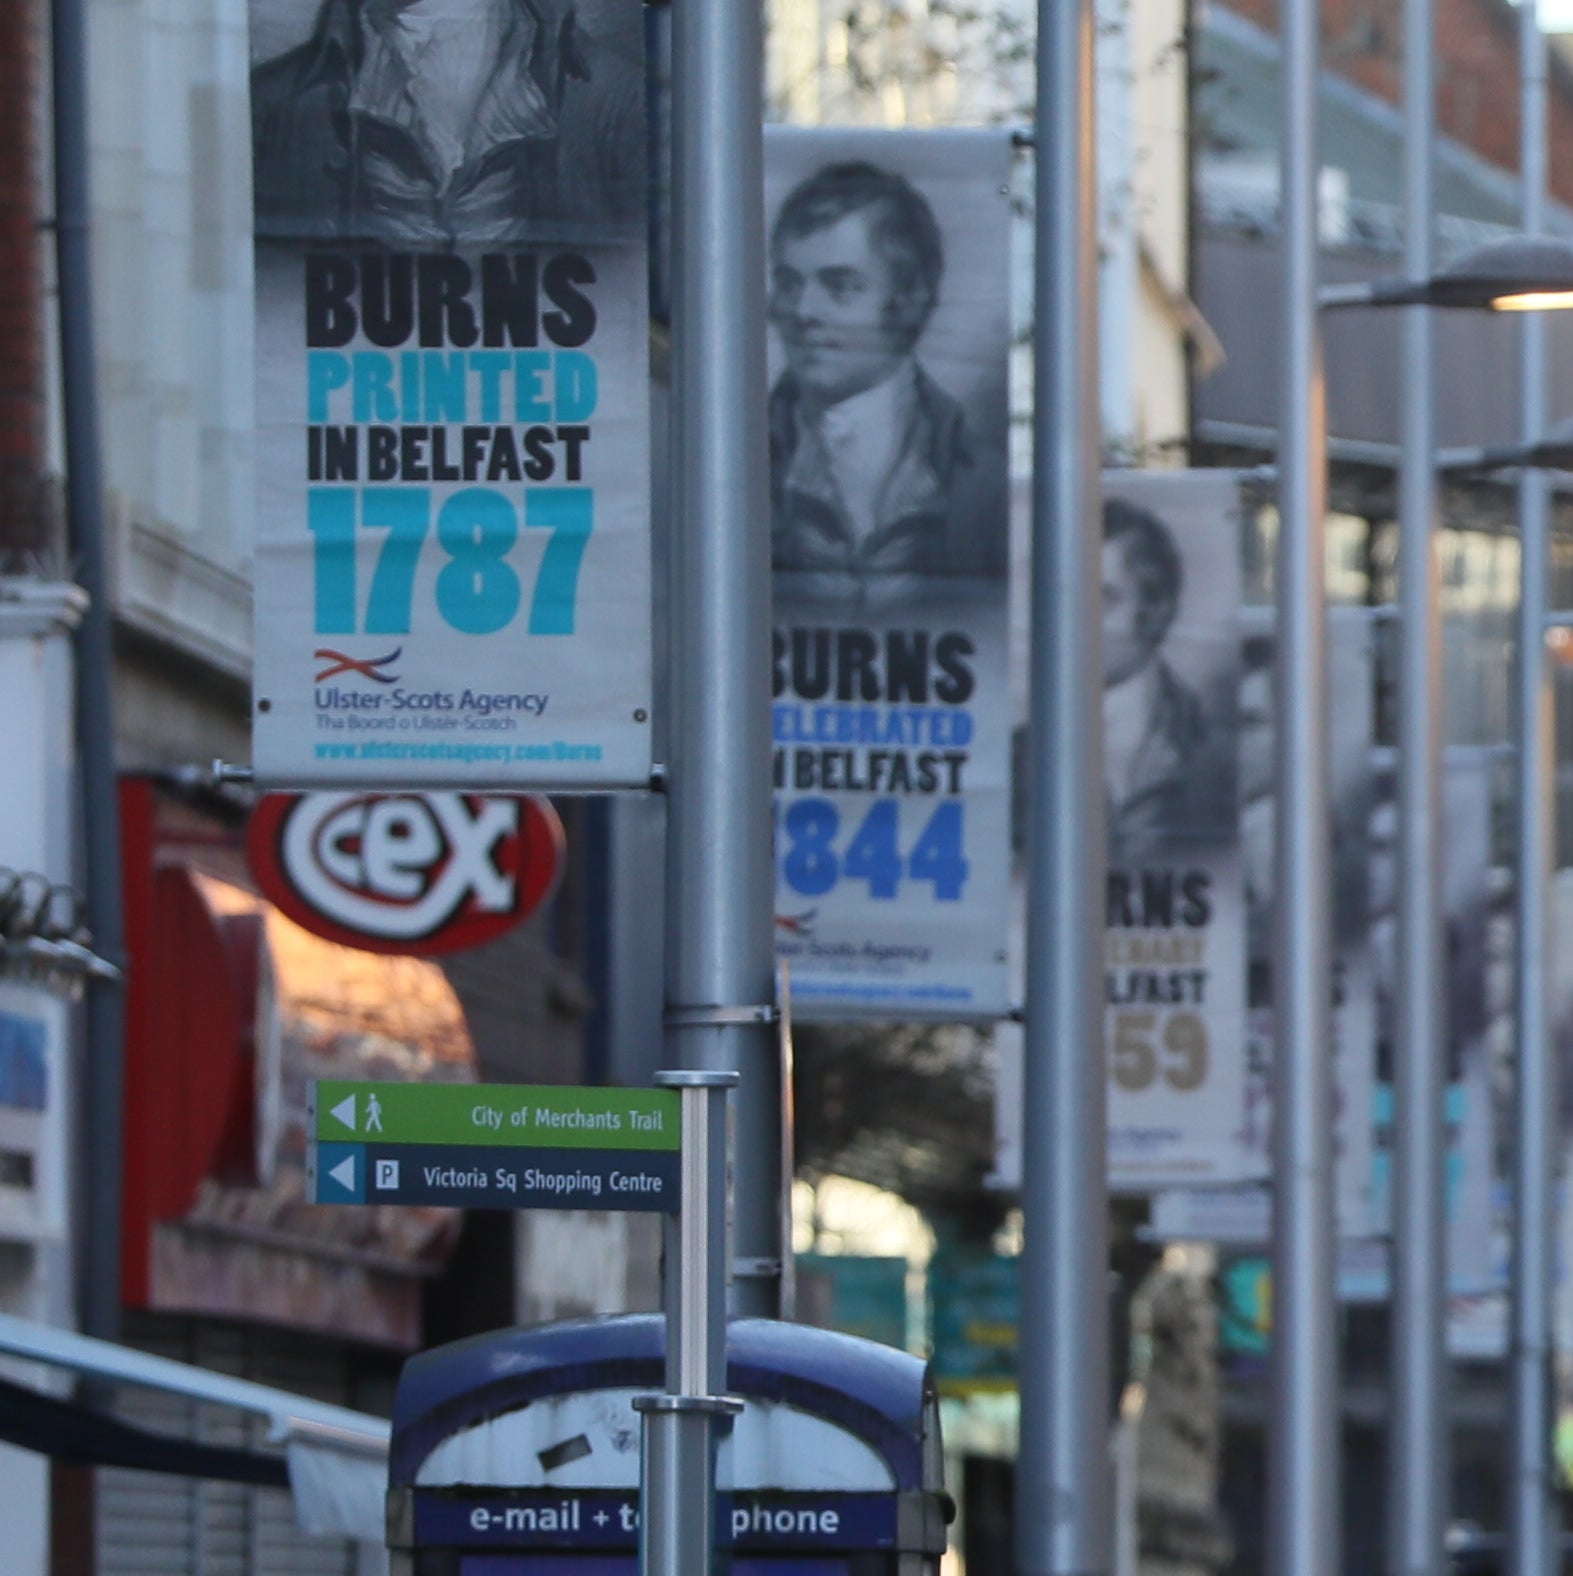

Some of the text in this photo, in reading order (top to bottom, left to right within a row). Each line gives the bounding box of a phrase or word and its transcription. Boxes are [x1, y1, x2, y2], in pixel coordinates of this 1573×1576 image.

[306, 254, 597, 347] BURNS
[307, 350, 598, 423] PRINTED
[308, 426, 590, 481] IN BELFAST
[308, 488, 594, 635] 1787
[315, 688, 548, 716] Ulster-Scots Agency
[773, 706, 974, 746] ELEBRATED
[794, 750, 969, 793] BELFAST
[774, 797, 969, 902] 844
[472, 1105, 663, 1131] City of Merchants Trail
[424, 1165, 488, 1189] Victoria
[496, 1168, 517, 1193] Sq
[525, 1168, 601, 1196] Shopping
[609, 1171, 663, 1193] Centre
[470, 1501, 580, 1531] e-mail
